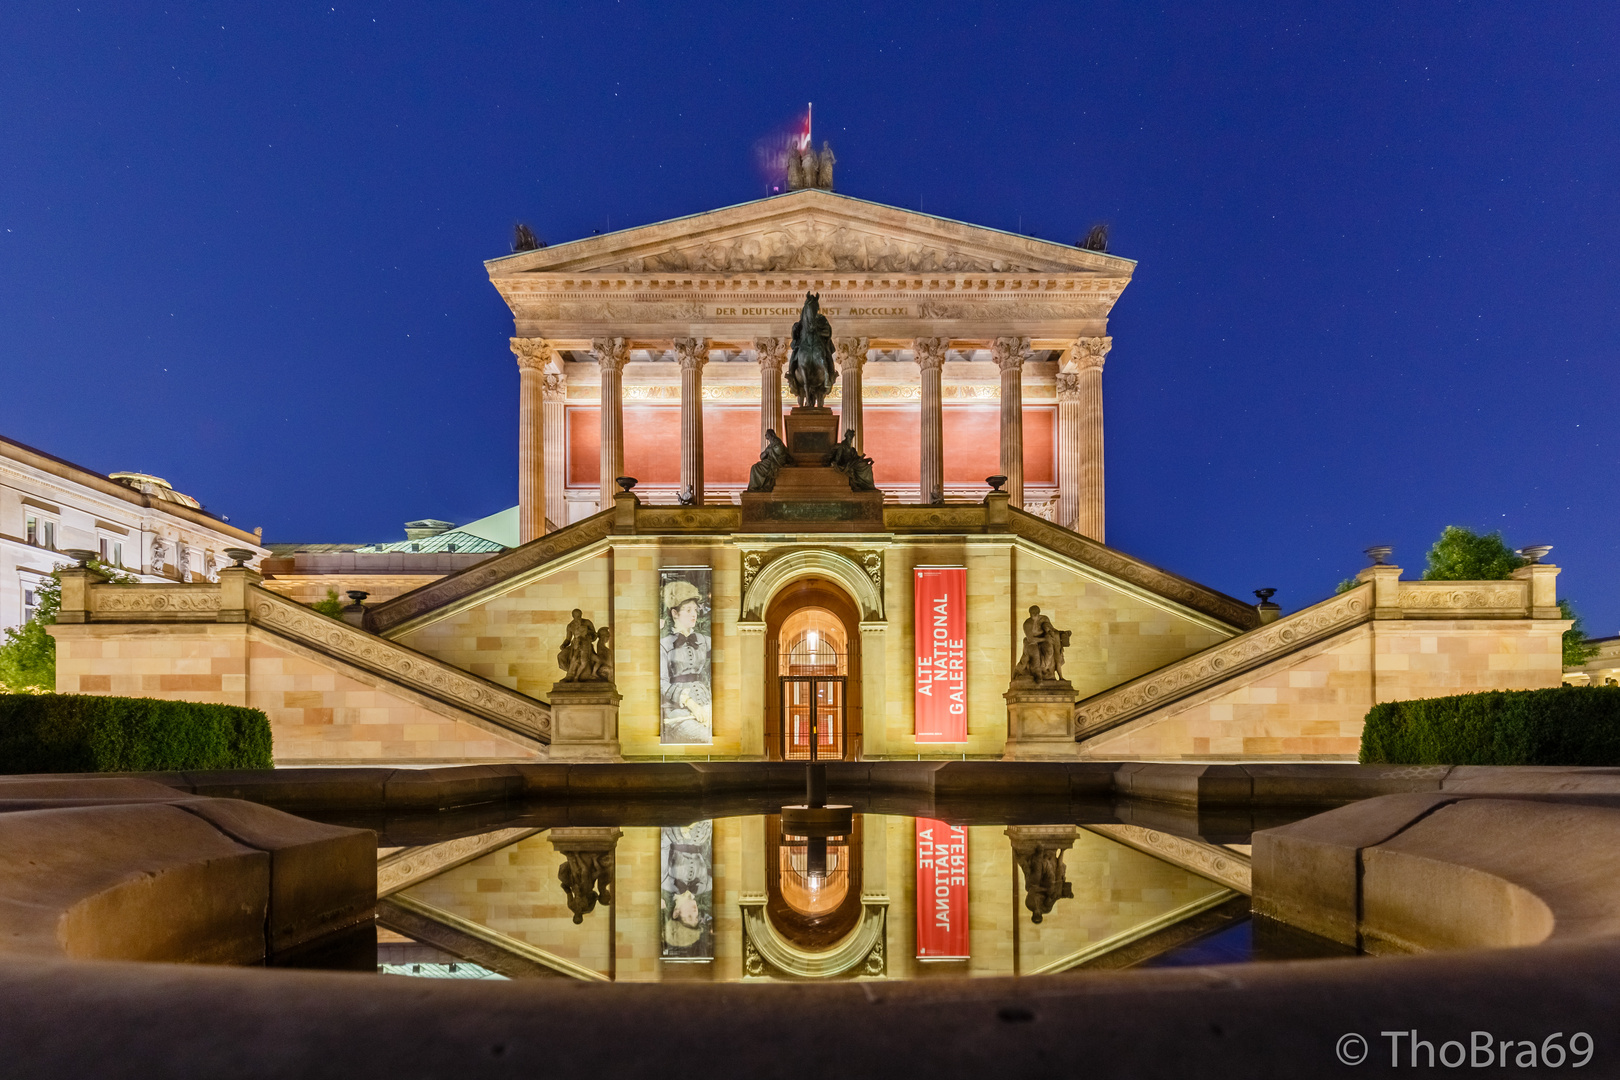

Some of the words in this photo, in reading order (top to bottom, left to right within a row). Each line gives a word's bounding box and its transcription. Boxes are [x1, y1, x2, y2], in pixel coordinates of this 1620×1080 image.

[716, 307, 736, 315] DER
[742, 307, 802, 315] DEUTSCHEN
[849, 307, 908, 315] MDCCCLXXI
[933, 593, 948, 681] NATIONAL
[918, 656, 932, 696] ALTE
[949, 638, 964, 715] GALERIE
